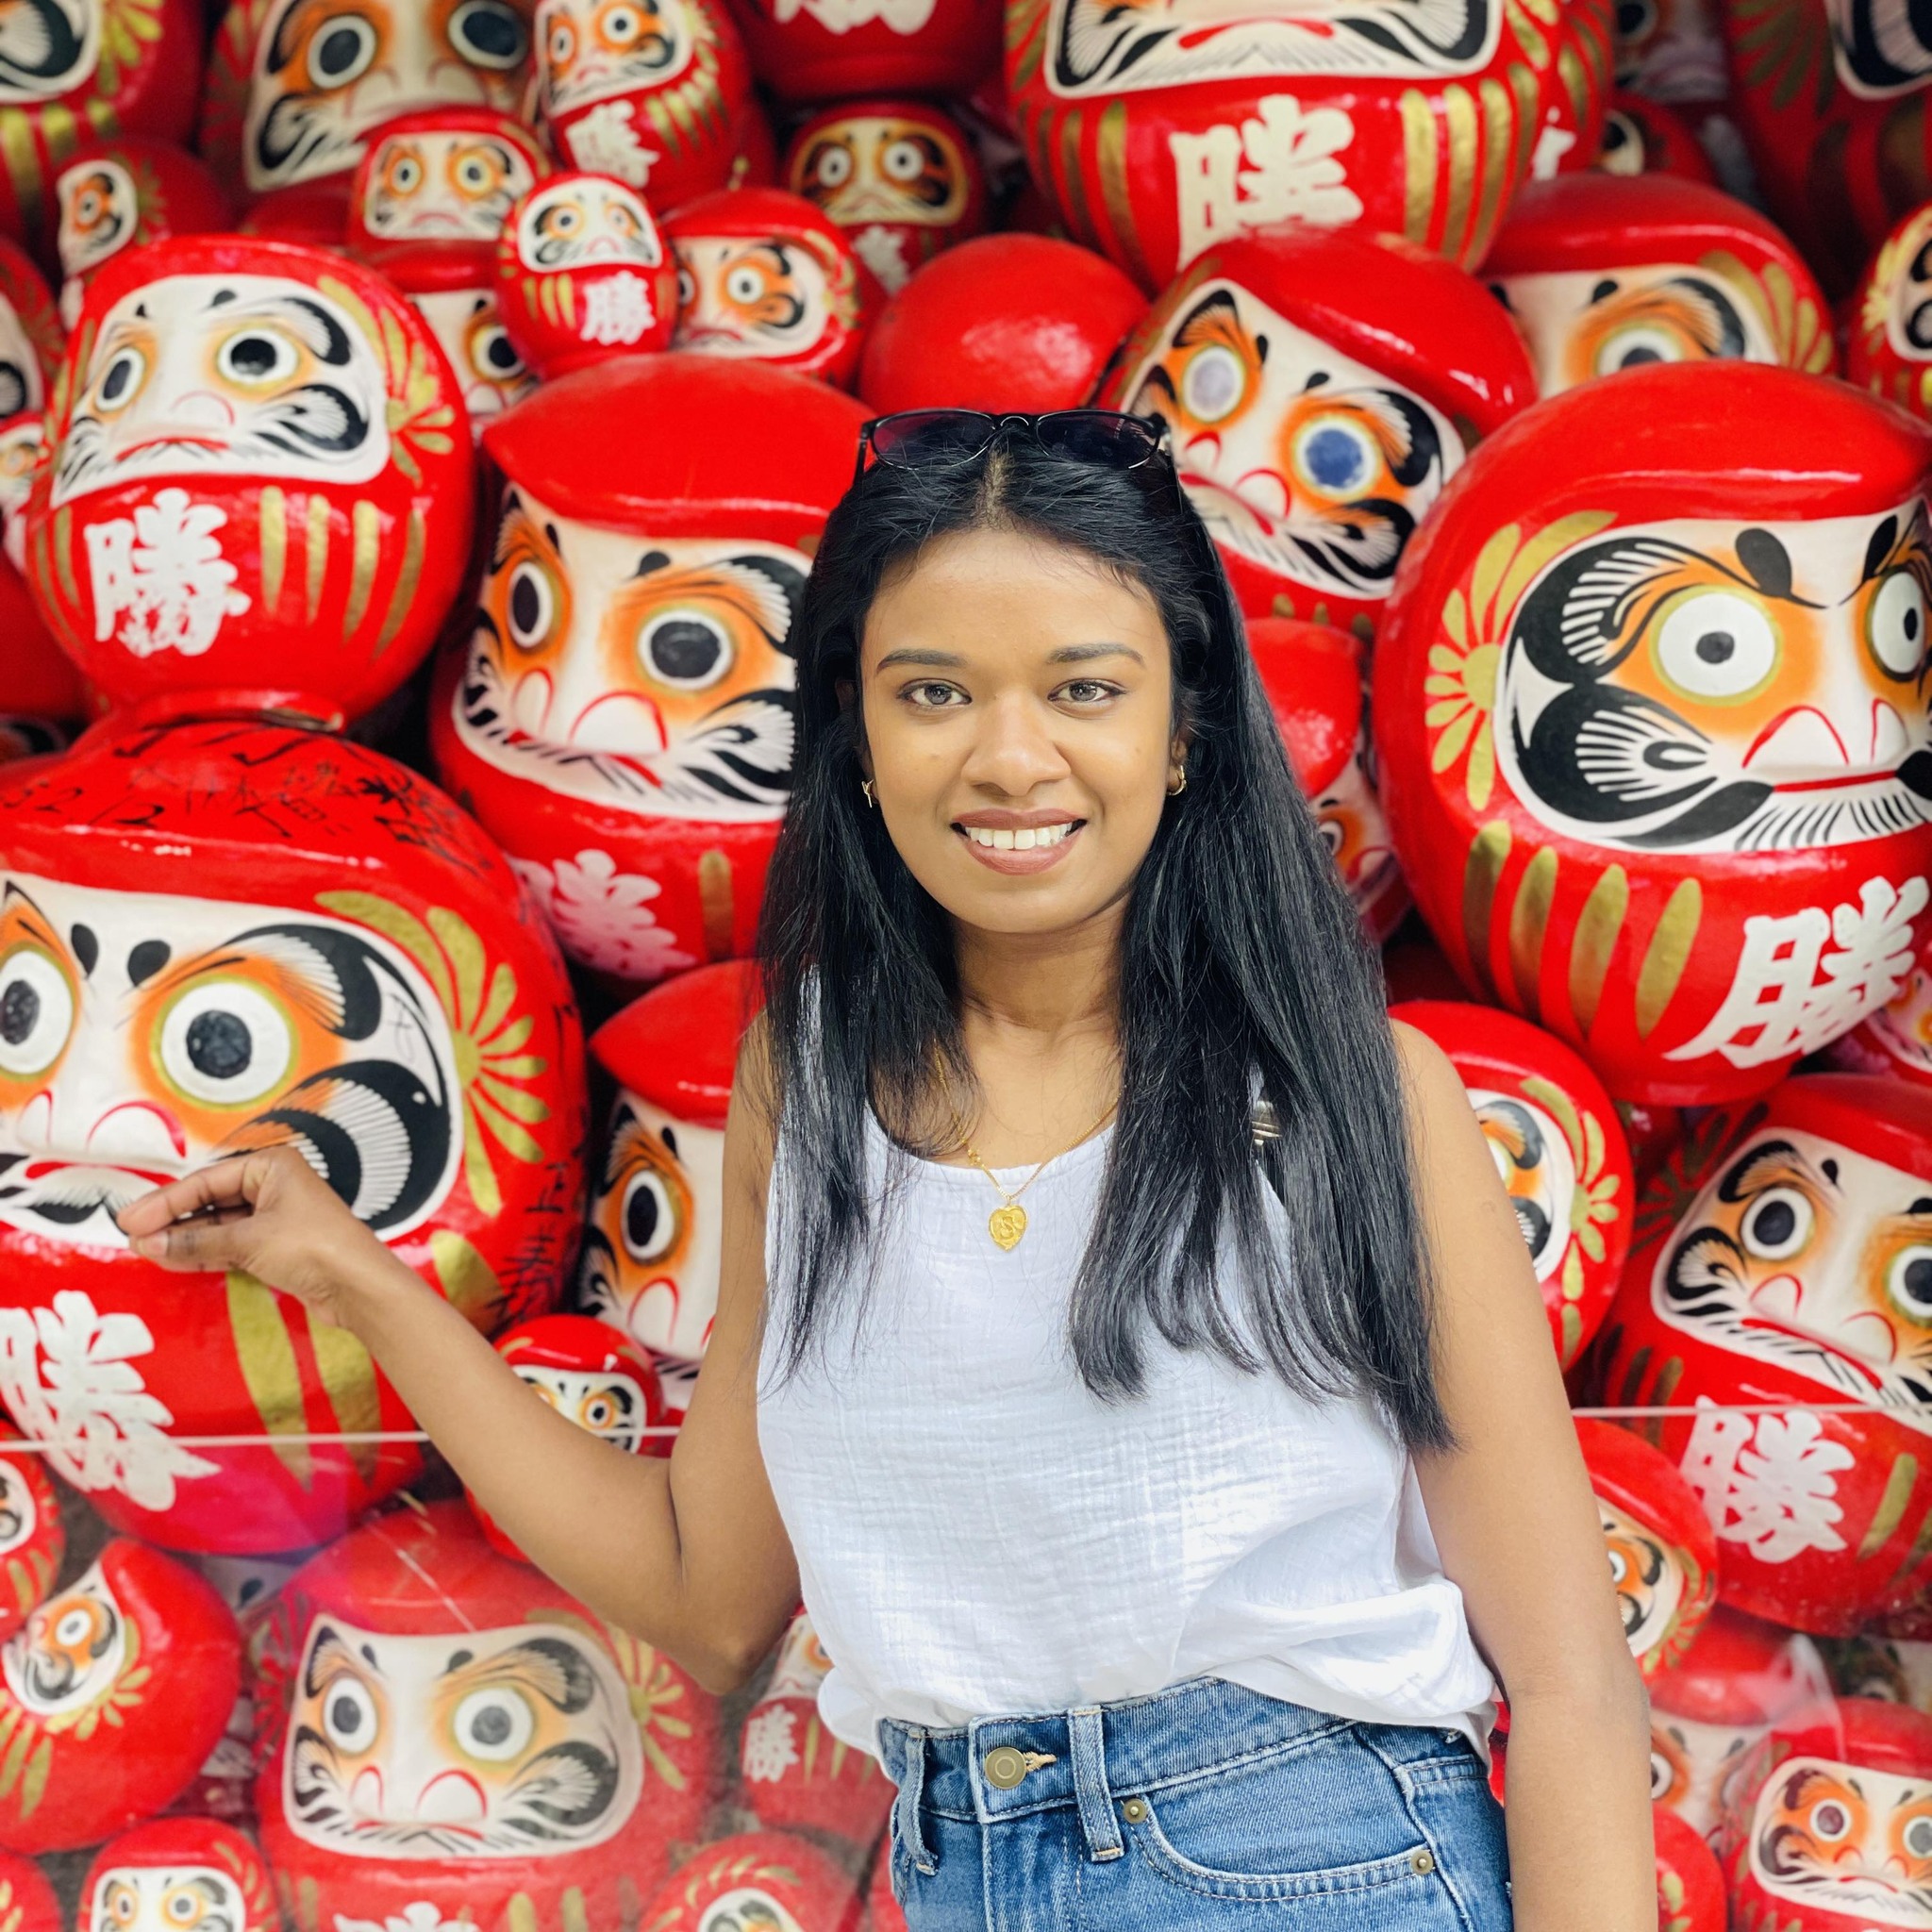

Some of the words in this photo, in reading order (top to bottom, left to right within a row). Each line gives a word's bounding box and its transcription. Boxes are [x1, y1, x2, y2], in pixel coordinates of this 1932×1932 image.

[579, 270, 657, 345] 勝
[83, 486, 252, 658] 勝
[1662, 876, 1929, 1069] 勝
[0, 1290, 222, 1511] 勝
[1680, 1394, 1856, 1563] 勝
